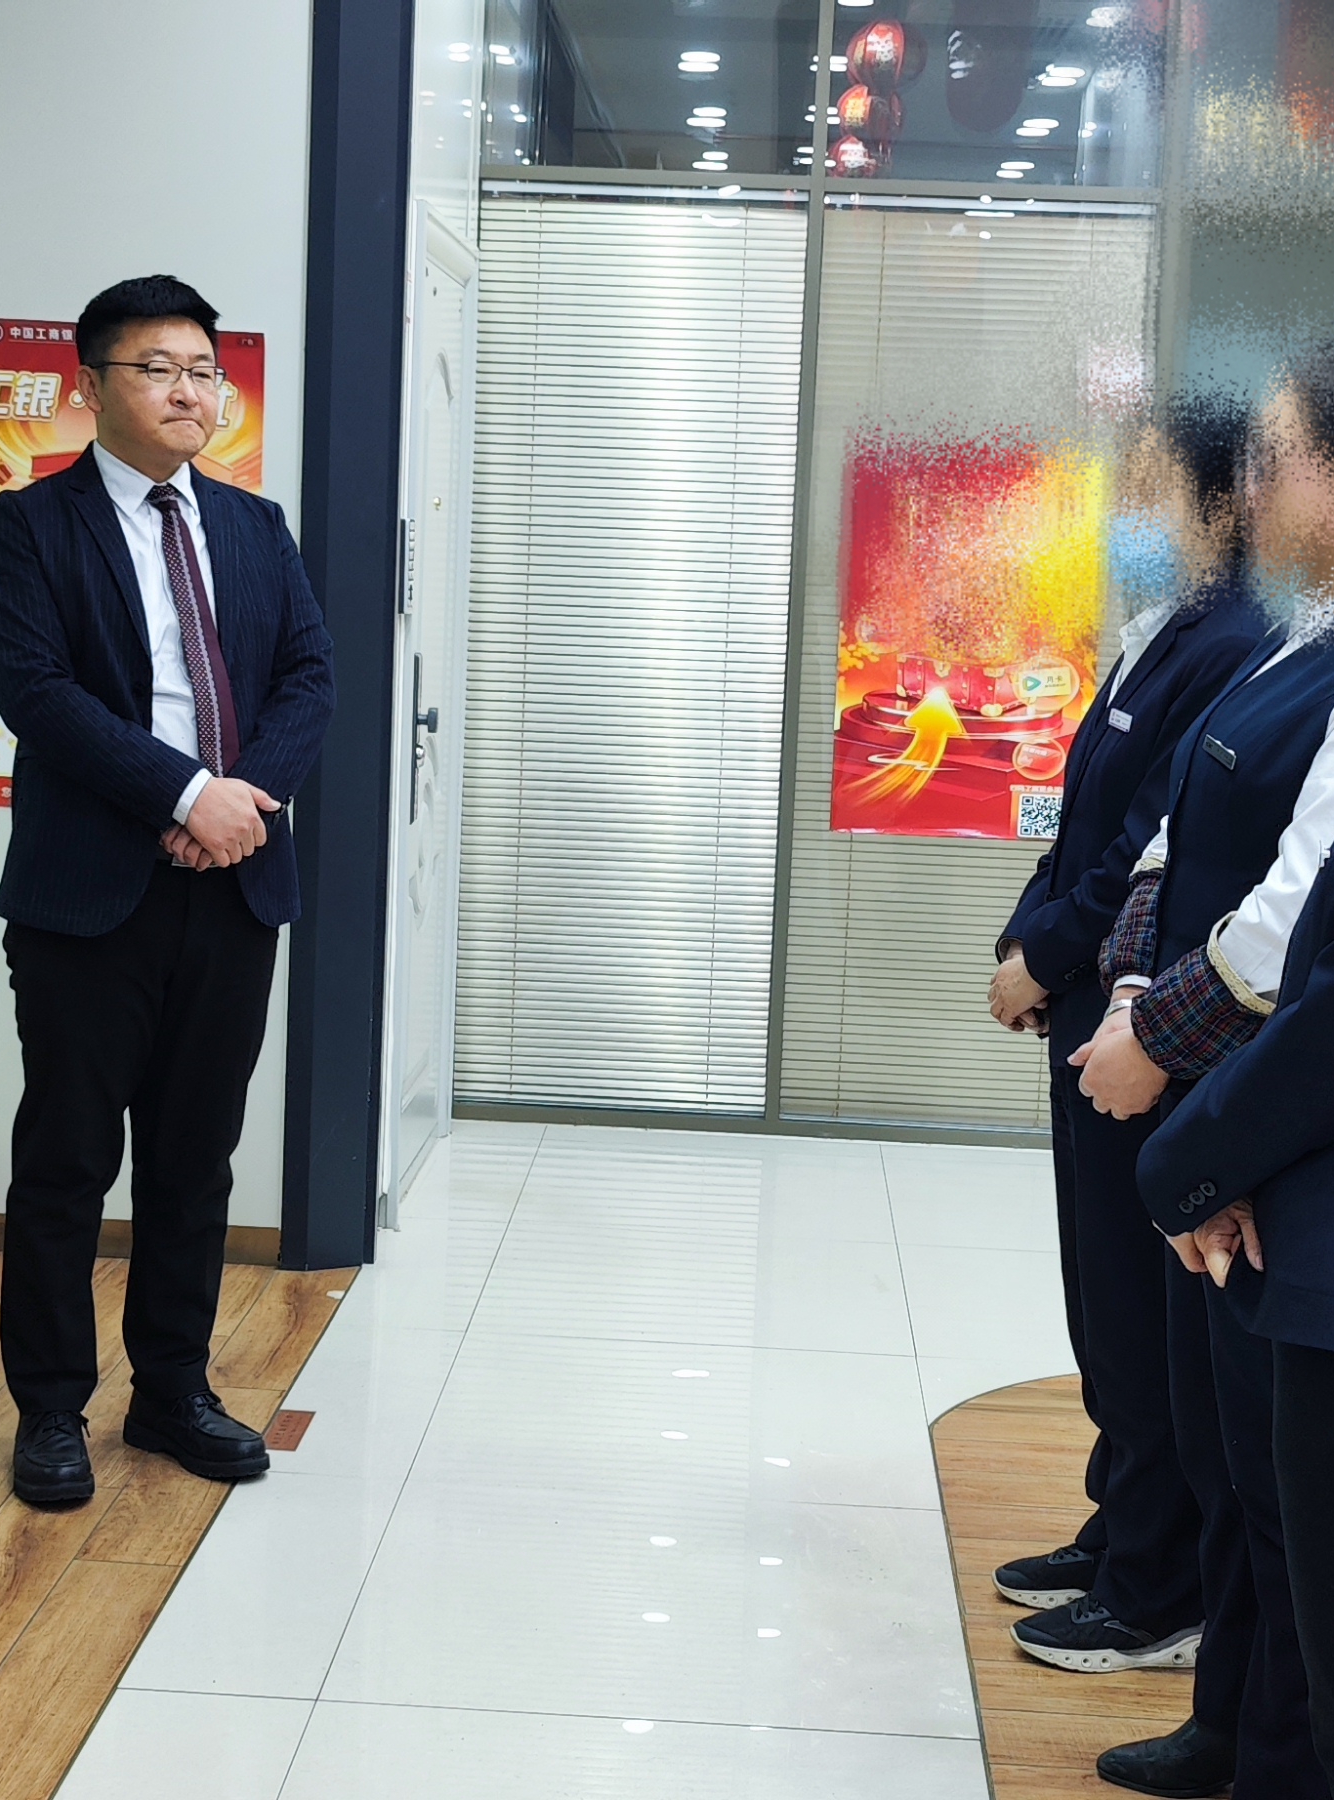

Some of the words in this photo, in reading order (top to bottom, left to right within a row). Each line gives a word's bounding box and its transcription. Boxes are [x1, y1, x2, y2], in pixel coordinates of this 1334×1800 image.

[10, 326, 74, 341] 中国工商银
